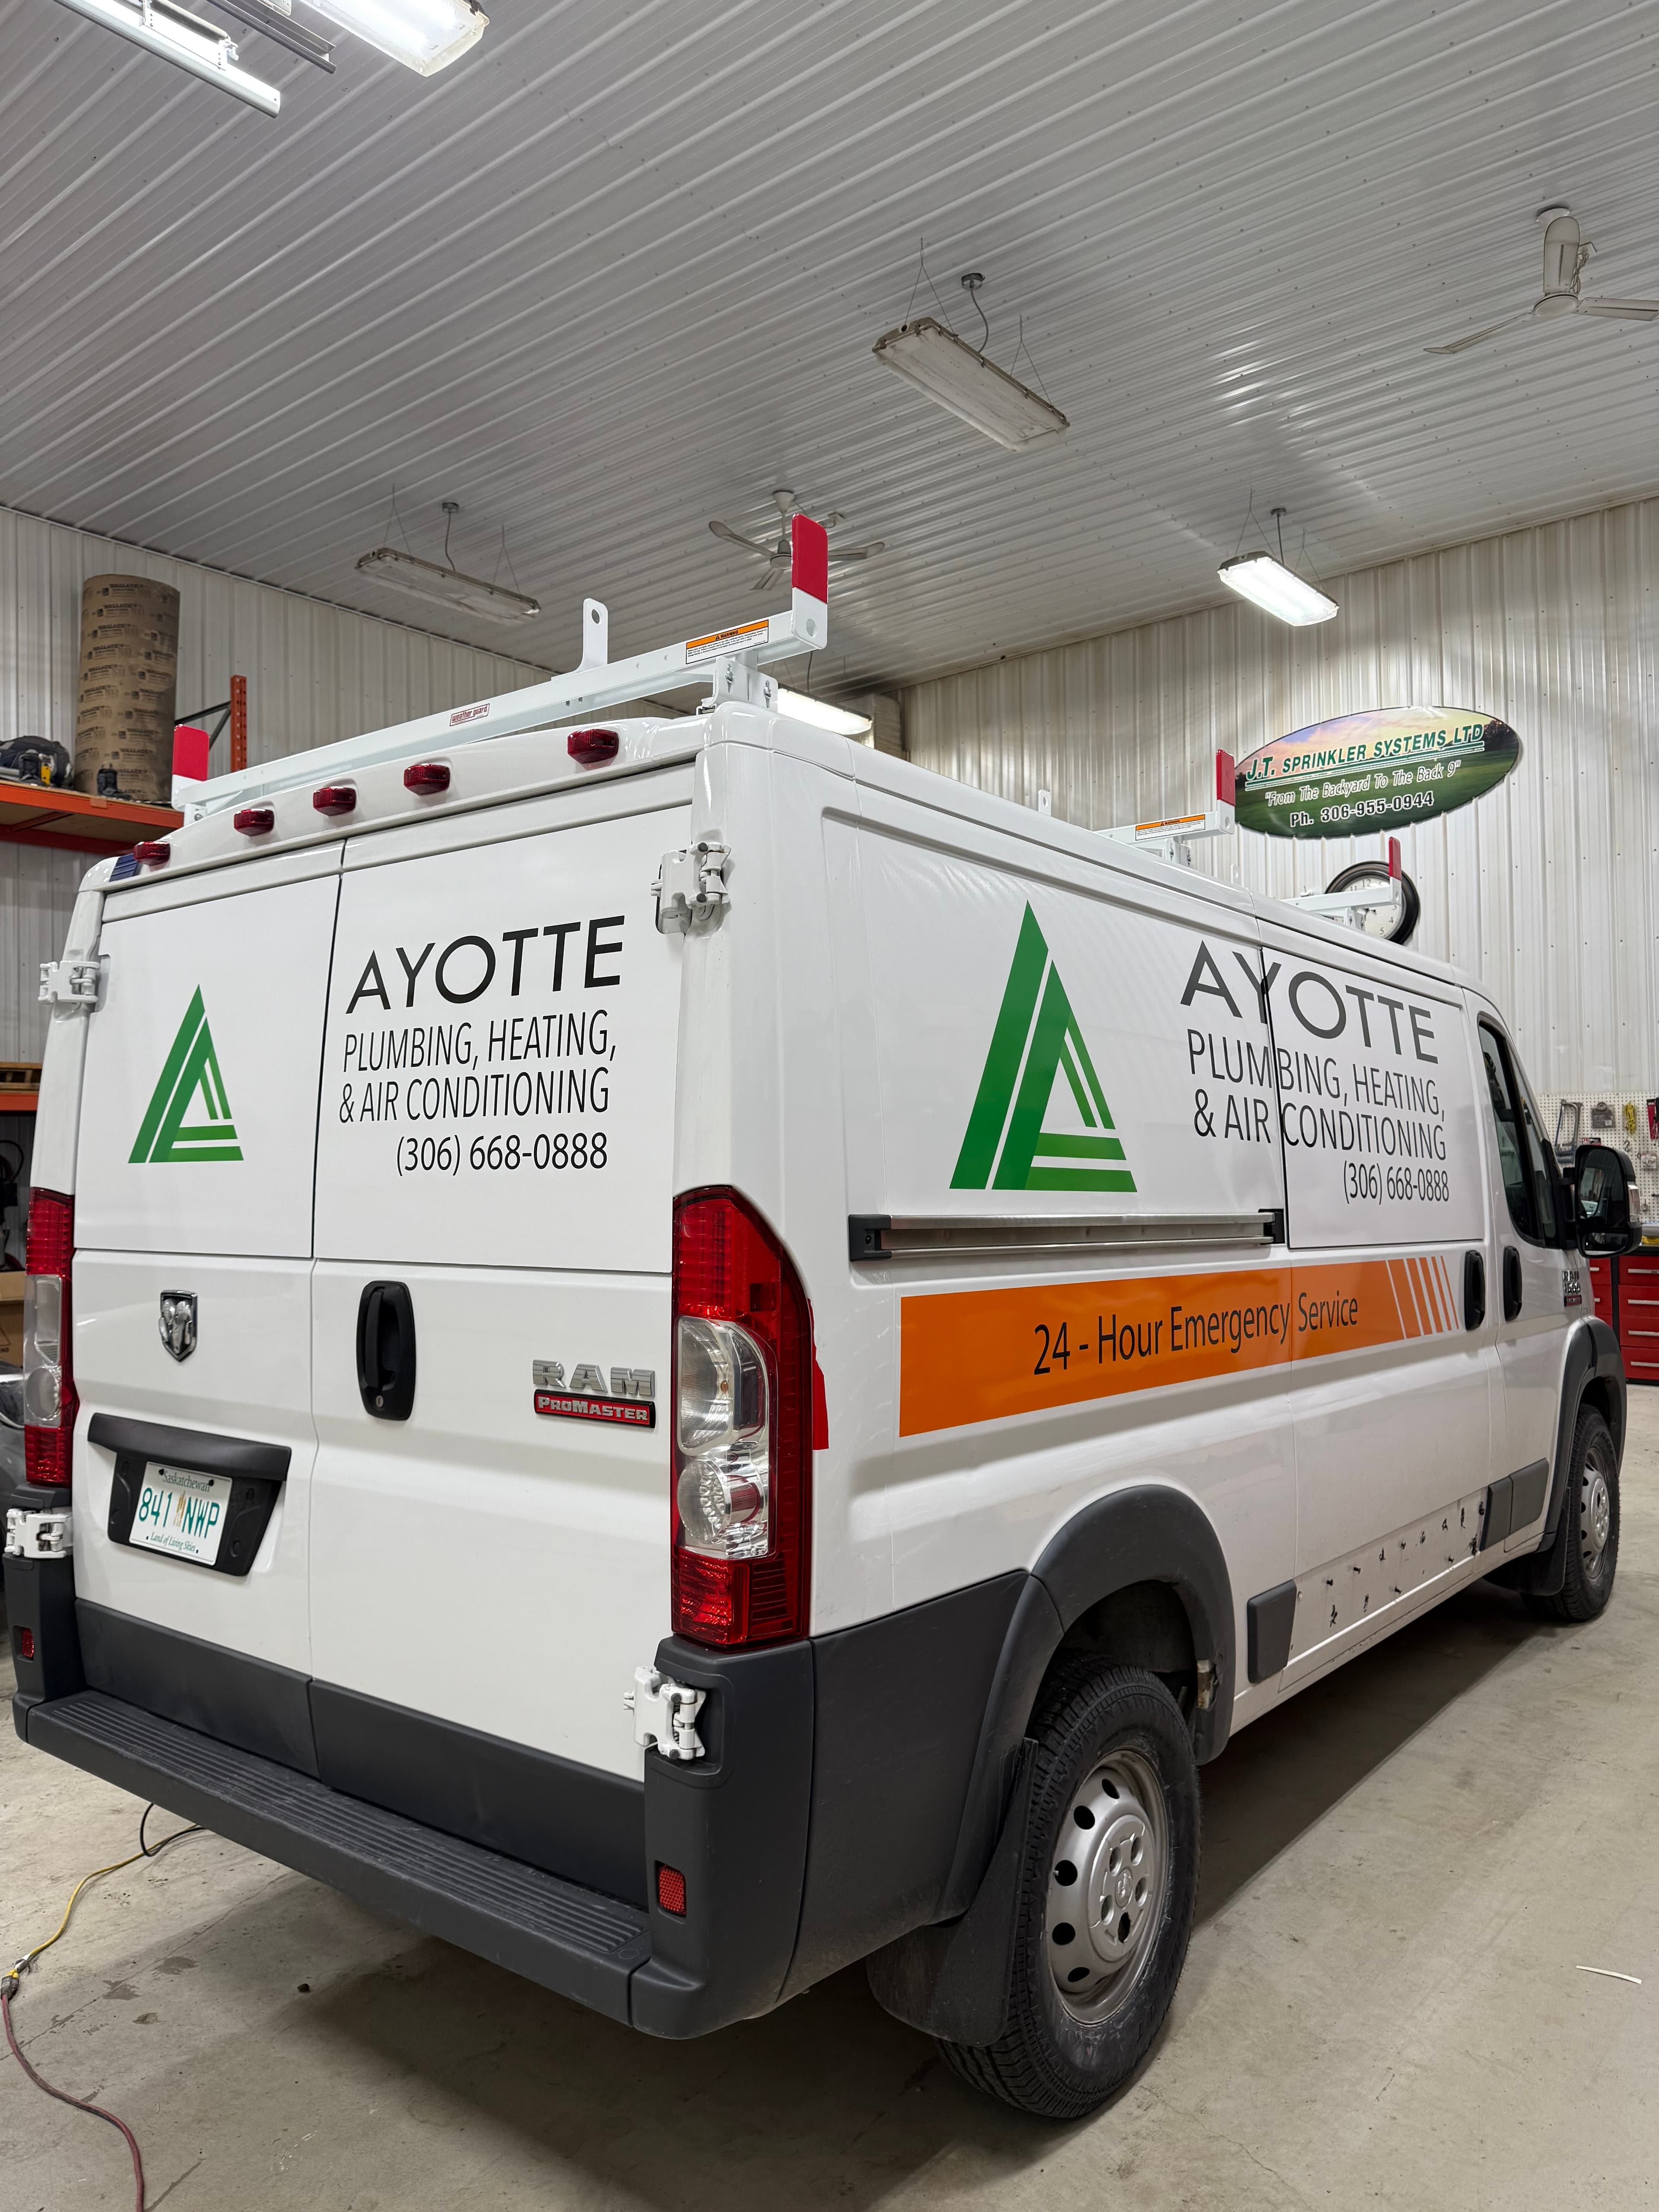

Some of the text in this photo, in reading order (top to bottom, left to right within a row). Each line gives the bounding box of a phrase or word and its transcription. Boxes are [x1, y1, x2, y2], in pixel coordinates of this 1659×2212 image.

[452, 711, 472, 721] weather
[1246, 724, 1483, 780] J.T. SPRINKLER SYSTEMS LTD
[1265, 760, 1462, 807] "From The Backyard To The Back 9"
[1290, 791, 1434, 828] Ph. 306-955-0944
[346, 915, 625, 1014] AYOTTE
[1180, 940, 1438, 1064] AYOTTE
[343, 1010, 616, 1072] PLUMBING, HEATING,
[339, 1067, 608, 1123] & AIR CONDITIONING
[1187, 1028, 1444, 1122] PLUMBING, HEATING,
[1194, 1089, 1446, 1160] & AIR CONDITIONING
[397, 1132, 607, 1176] (306) 668-0888
[1344, 1160, 1449, 1205] (306) 668-0888
[1034, 1322, 1070, 1375] 24
[1098, 1314, 1163, 1364] Hour
[1171, 1302, 1290, 1354] Emergency
[1298, 1291, 1358, 1332] Service
[533, 1359, 655, 1398] RAM
[162, 1471, 210, 1492] Saskatchewan
[139, 1487, 220, 1538] 841 NWP
[150, 1532, 163, 1543] Land
[162, 1535, 170, 1547] of
